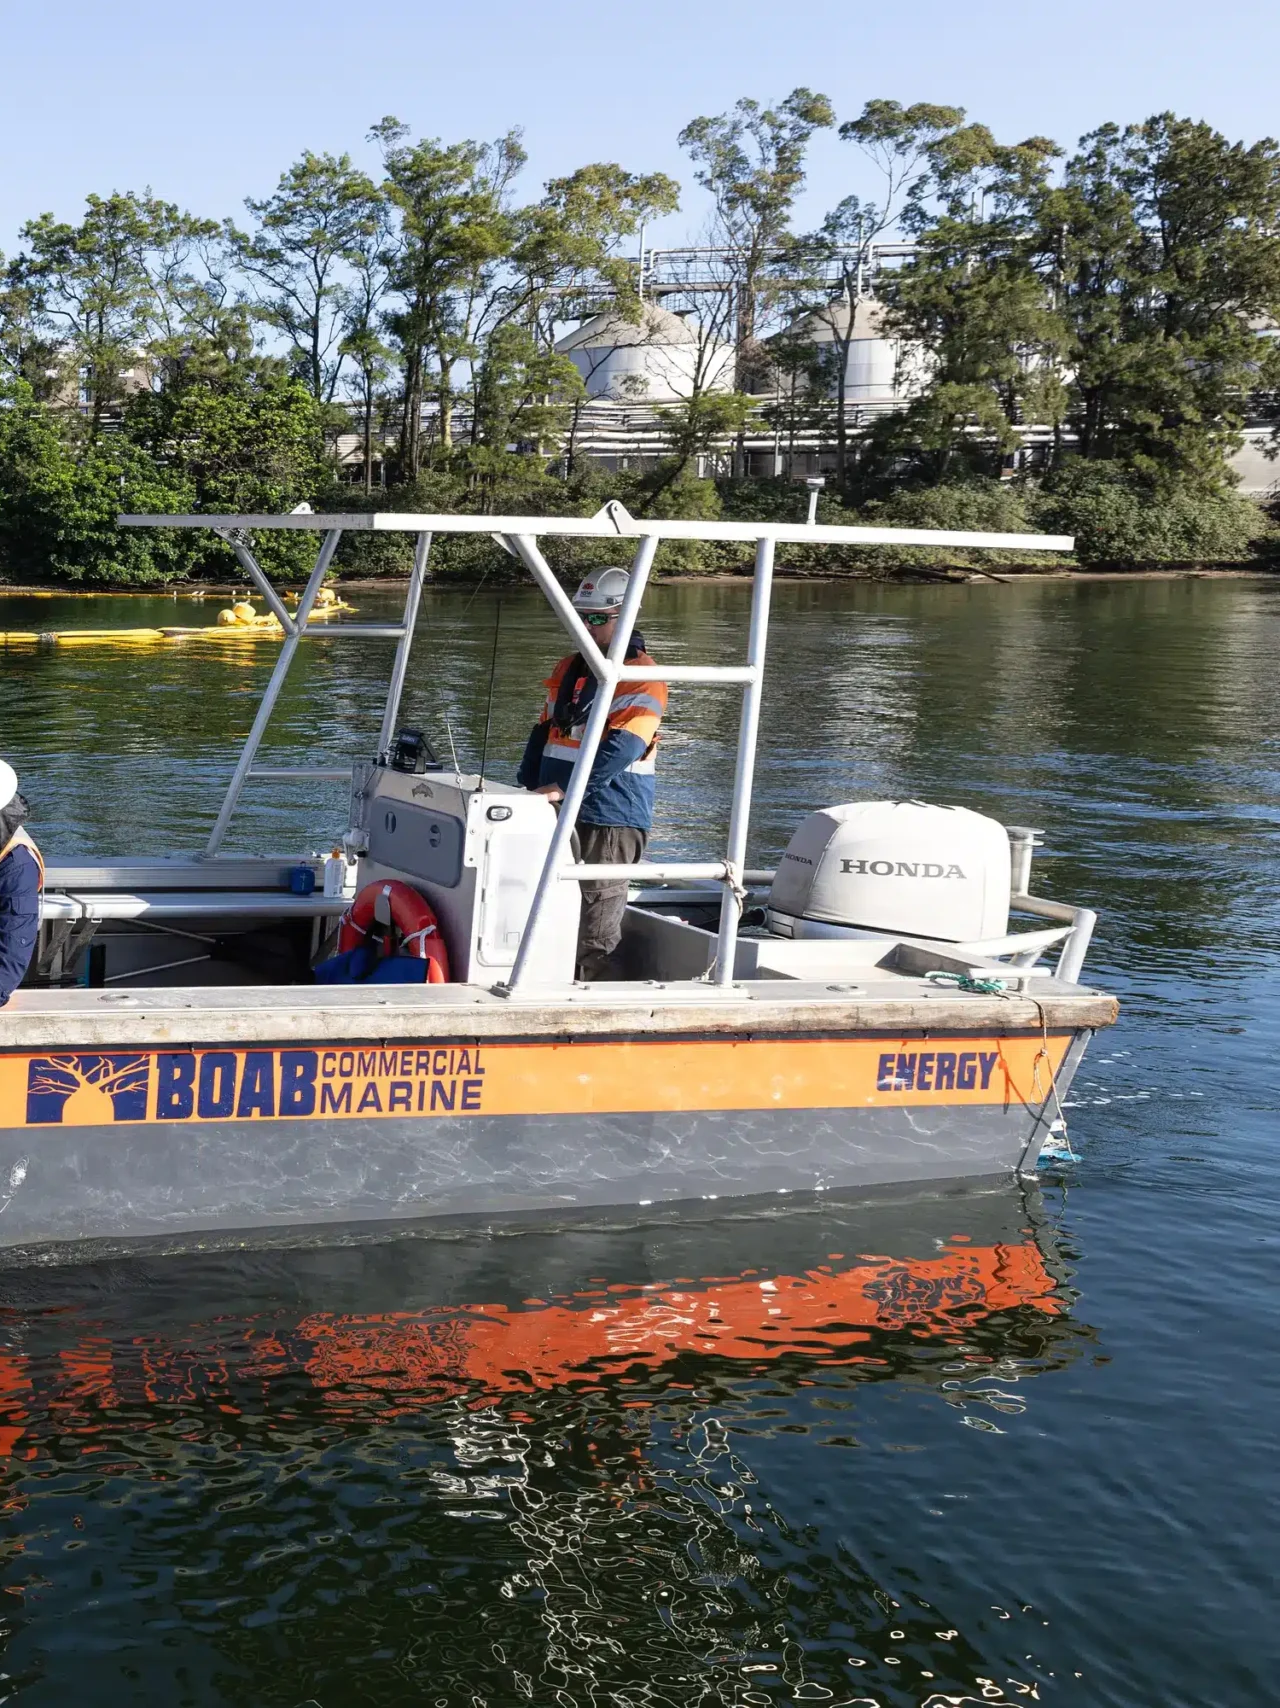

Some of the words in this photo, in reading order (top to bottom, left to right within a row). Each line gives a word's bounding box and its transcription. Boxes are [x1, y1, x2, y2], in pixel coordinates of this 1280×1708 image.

[784, 852, 813, 866] HONDA
[839, 859, 967, 879] HONDA
[322, 1050, 485, 1078] COMMERCIAL
[877, 1052, 999, 1091] ENERGY
[156, 1051, 319, 1120] BOAB
[321, 1080, 483, 1114] MARINE
